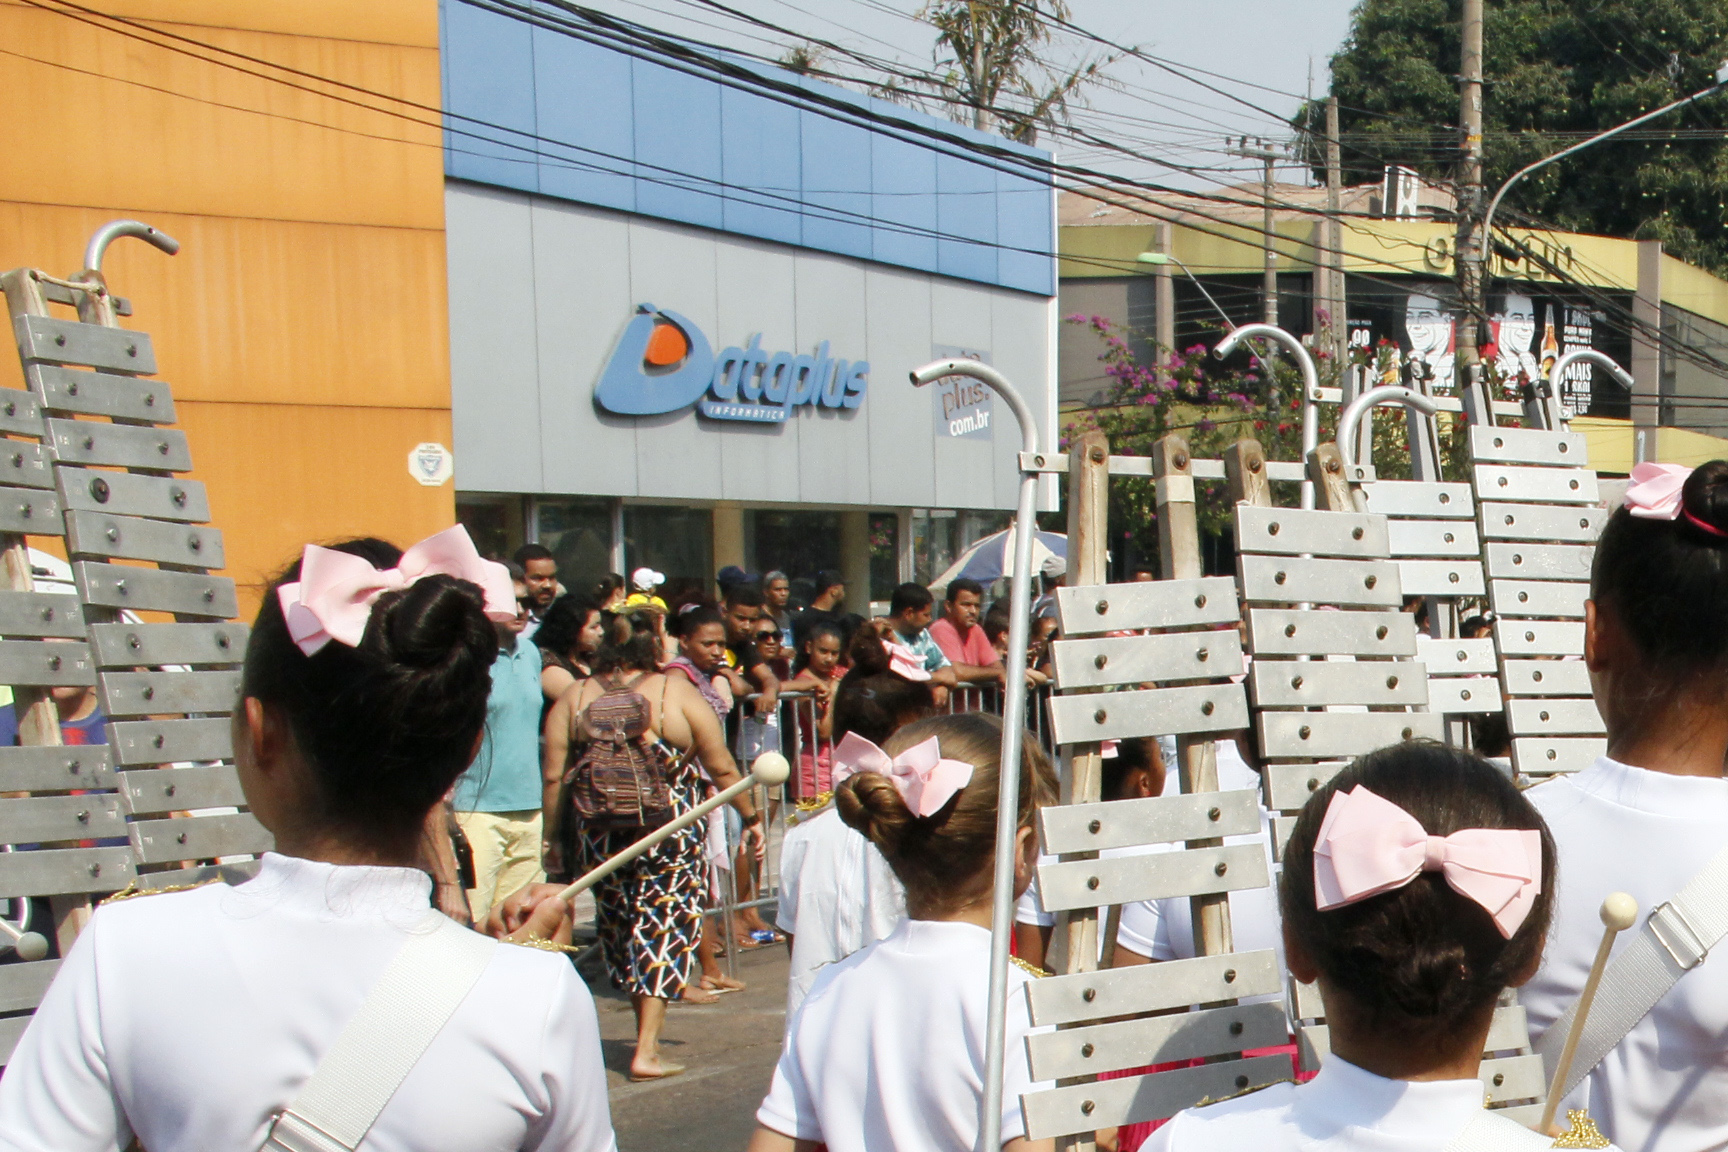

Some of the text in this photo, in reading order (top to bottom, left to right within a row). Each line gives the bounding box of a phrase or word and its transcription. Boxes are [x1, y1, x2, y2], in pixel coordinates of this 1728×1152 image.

[594, 303, 870, 415] Dataplus
[1565, 362, 1592, 381] MAIS
[950, 408, 990, 437] com.br
